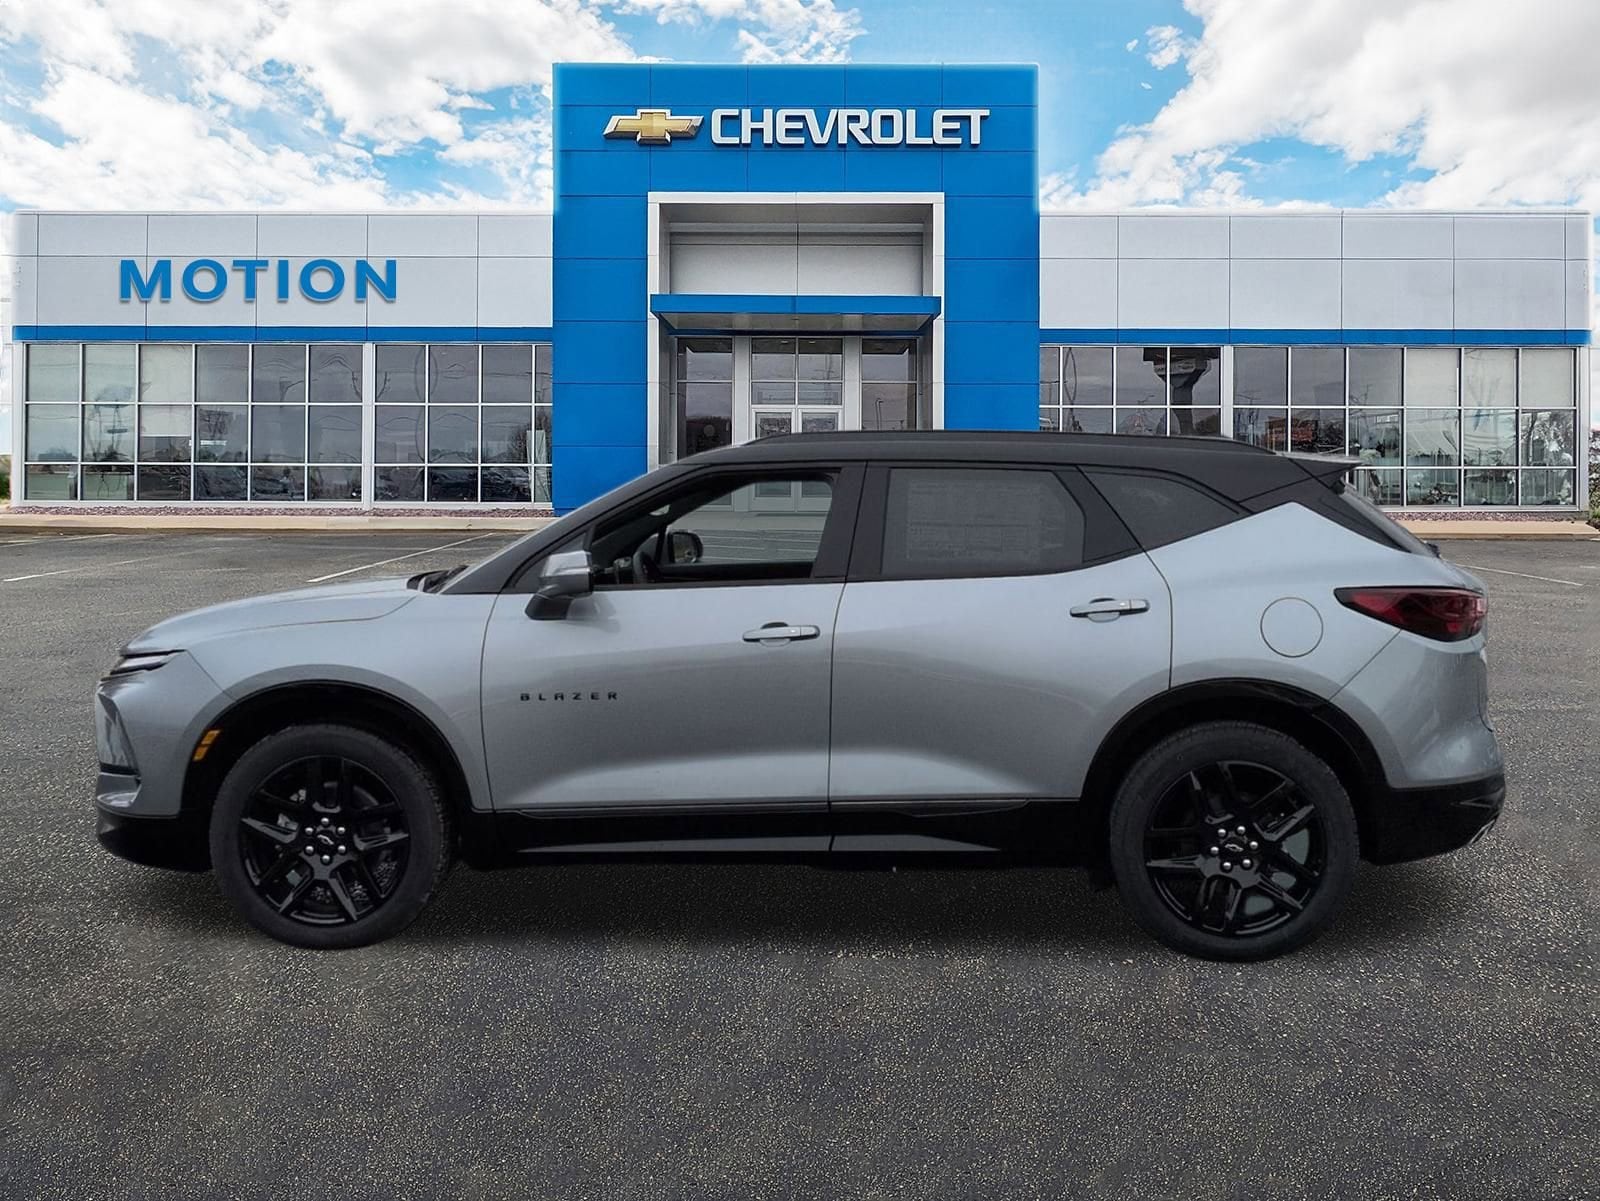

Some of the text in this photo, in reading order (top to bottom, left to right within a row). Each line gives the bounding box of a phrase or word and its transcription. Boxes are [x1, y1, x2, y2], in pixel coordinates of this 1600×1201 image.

[711, 109, 990, 145] CHEVROLET
[120, 259, 397, 302] MOTION
[519, 692, 618, 701] BLAZER
